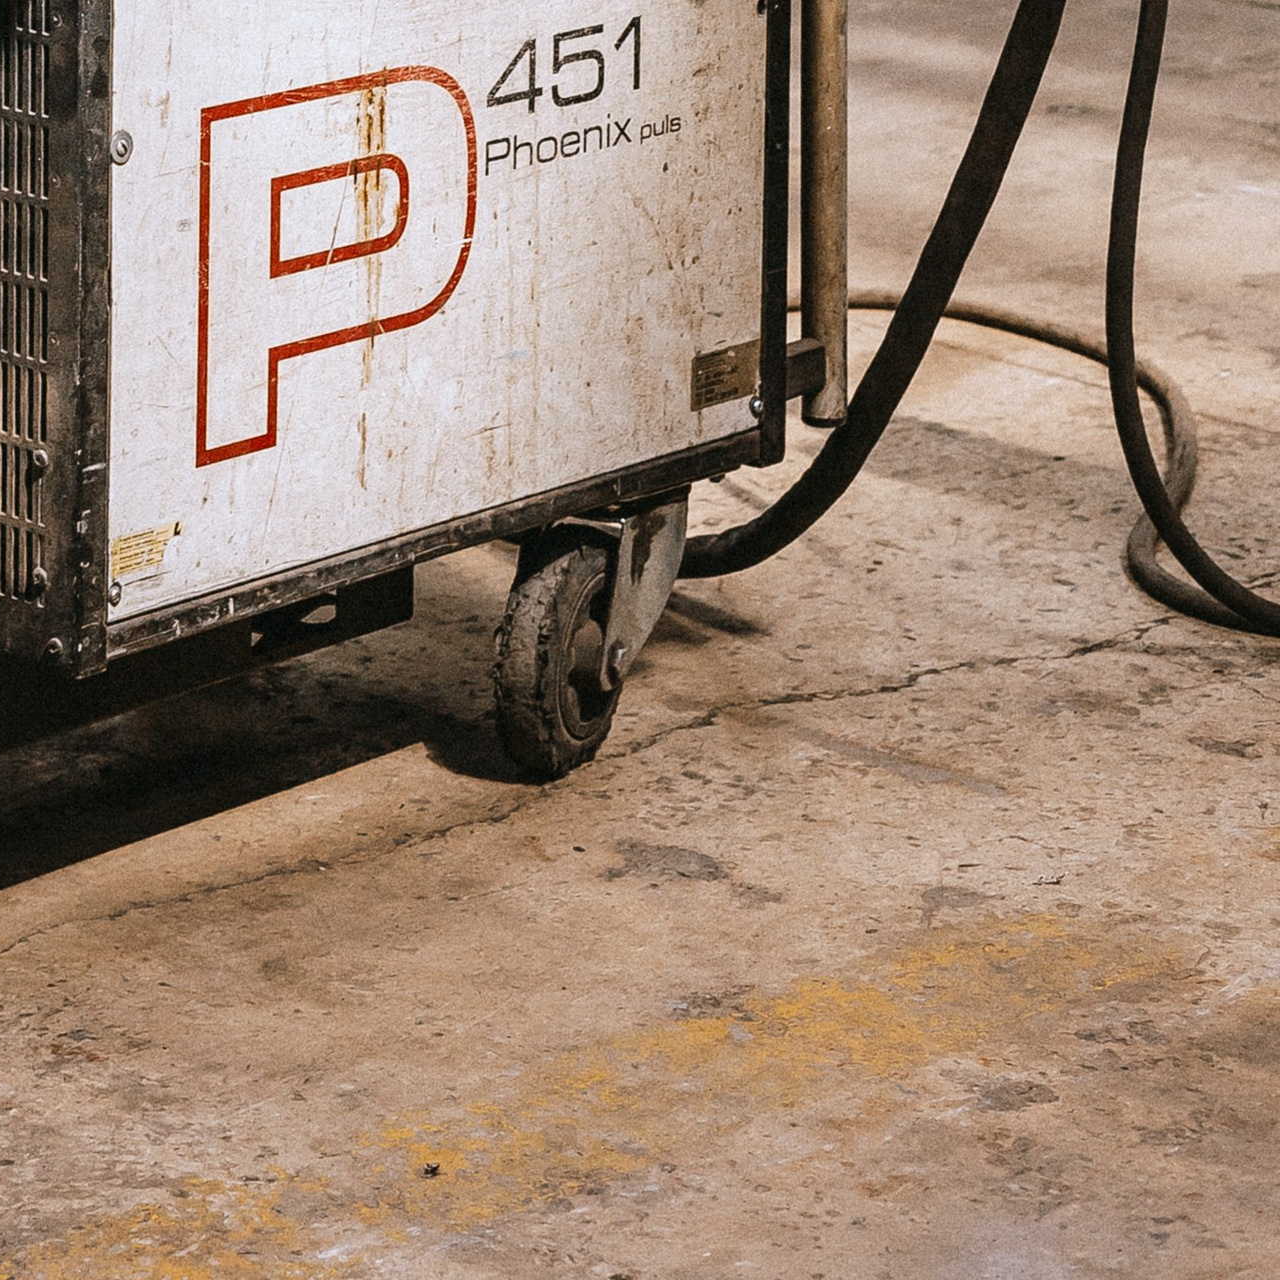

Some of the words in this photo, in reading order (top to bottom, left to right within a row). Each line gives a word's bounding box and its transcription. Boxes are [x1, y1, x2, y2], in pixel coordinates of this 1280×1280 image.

[486, 15, 642, 114] 451
[485, 113, 632, 177] Phoenix
[640, 114, 682, 145] puls
[195, 65, 477, 468] P
